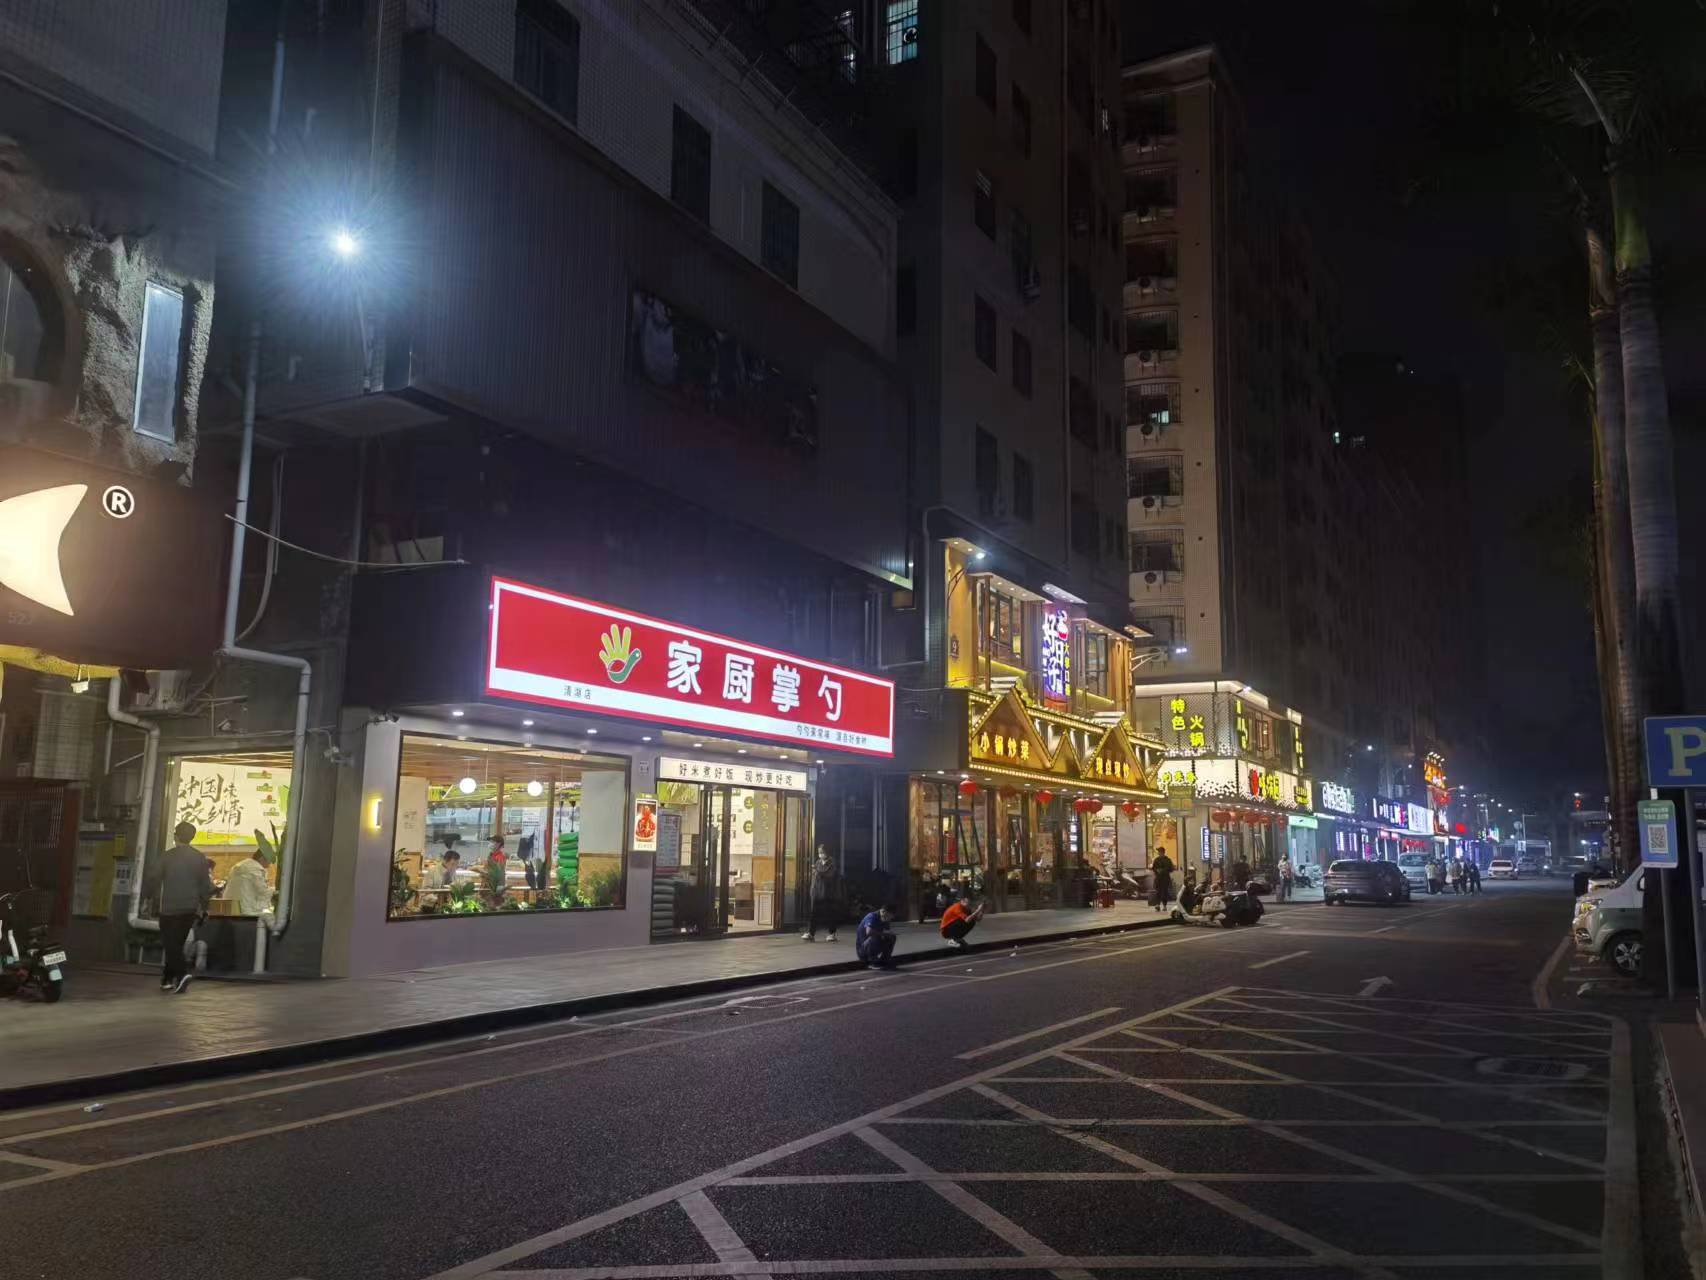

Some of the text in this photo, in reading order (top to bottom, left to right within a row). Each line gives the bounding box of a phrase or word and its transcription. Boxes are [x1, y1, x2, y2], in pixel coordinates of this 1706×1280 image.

[667, 640, 842, 721] 家厨掌勺
[1170, 698, 1186, 731] 特色
[1189, 715, 1205, 747] 火锅
[1663, 726, 1706, 777] P
[679, 762, 793, 786] 好米煮好饭 现炒更好吃
